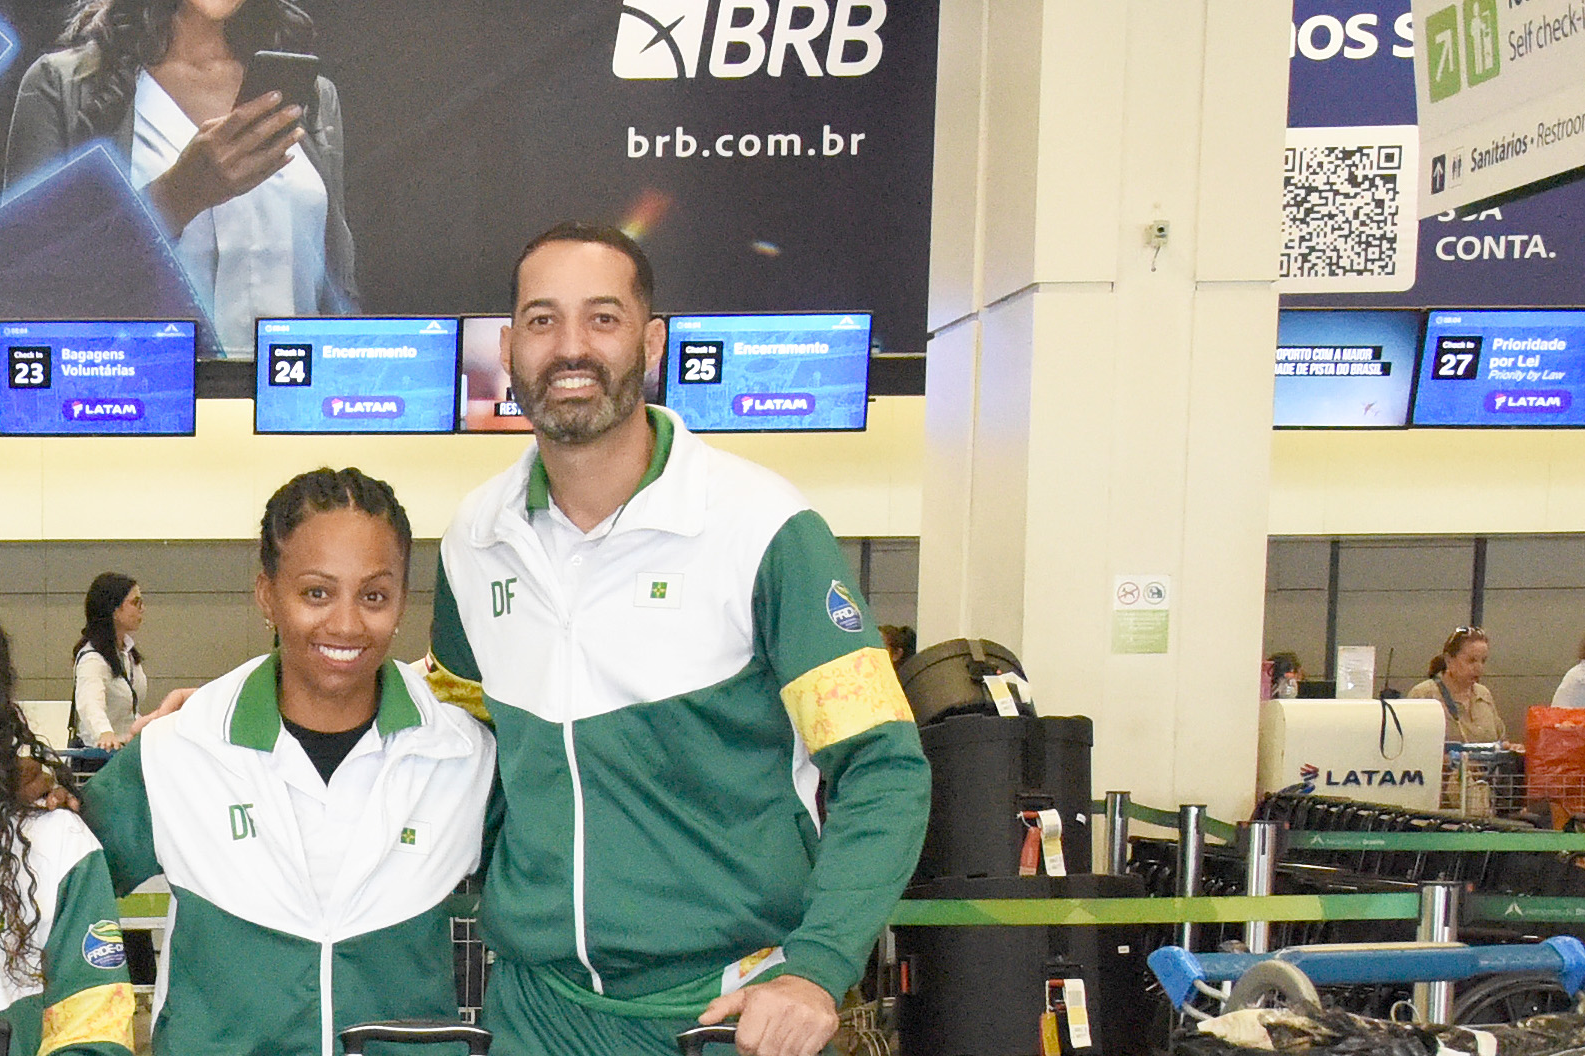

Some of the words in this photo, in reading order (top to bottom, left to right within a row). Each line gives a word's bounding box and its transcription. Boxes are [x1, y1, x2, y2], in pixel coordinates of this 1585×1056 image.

[709, 0, 887, 77] BRB
[1509, 21, 1533, 61] Self
[627, 125, 866, 158] brb.com.br
[1470, 132, 1528, 173] Sanitários
[1435, 235, 1557, 261] CONTA.
[733, 341, 830, 355] Encerramento
[1492, 338, 1566, 351] Prioridade
[61, 348, 125, 363] Bagagens
[322, 345, 418, 359] Encerramento
[1312, 348, 1335, 361] COM
[1334, 348, 1342, 360] A
[1342, 348, 1373, 360] MAIOR
[1296, 363, 1310, 375] DE
[1309, 363, 1335, 375] PISTA
[1336, 363, 1350, 375] DO
[1439, 353, 1473, 376] 27
[1489, 356, 1515, 369] por
[1517, 355, 1540, 367] Lei
[14, 362, 44, 384] 23
[61, 364, 135, 377] Voluntárias
[275, 361, 305, 383] 24
[684, 358, 716, 381] 25
[1488, 370, 1526, 382] Priority
[1526, 370, 1542, 382] by
[1542, 370, 1566, 380] Law
[345, 402, 398, 413] LATAM
[754, 398, 808, 410] LATAM
[1507, 396, 1561, 407] LATAM
[85, 404, 137, 415] LATAM
[490, 577, 518, 618] DF
[1325, 769, 1424, 787] LATAM
